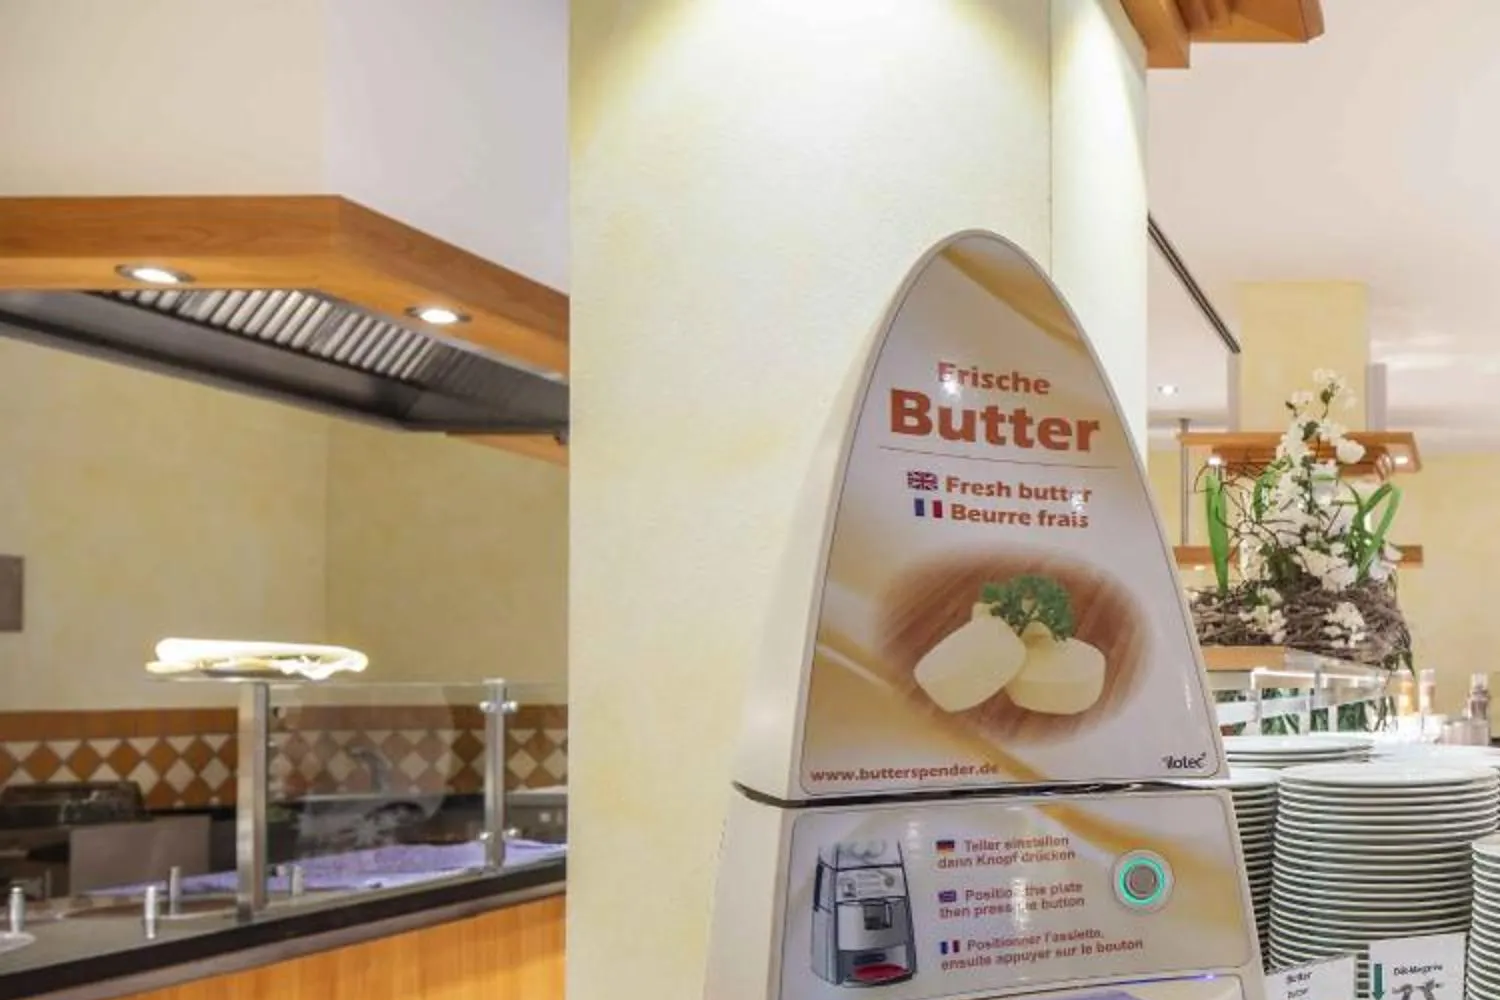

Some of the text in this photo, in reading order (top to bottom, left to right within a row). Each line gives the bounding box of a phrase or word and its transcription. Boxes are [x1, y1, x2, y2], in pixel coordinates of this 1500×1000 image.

[937, 361, 1051, 395] Frische
[889, 388, 1100, 453] Butter
[945, 476, 1012, 498] Fresh
[951, 502, 1090, 529] Beurre frais
[810, 761, 998, 782] www.butterspender.de
[964, 839, 1002, 852] Teller
[938, 856, 972, 869] dann
[976, 851, 1018, 866] Knopf
[965, 881, 1083, 902] Positio the plate
[939, 907, 970, 919] then
[974, 903, 1012, 919] press
[1041, 896, 1085, 910] button
[967, 936, 1041, 951] Positionner
[941, 939, 1143, 971] ensuite appuyer sur le bouton
